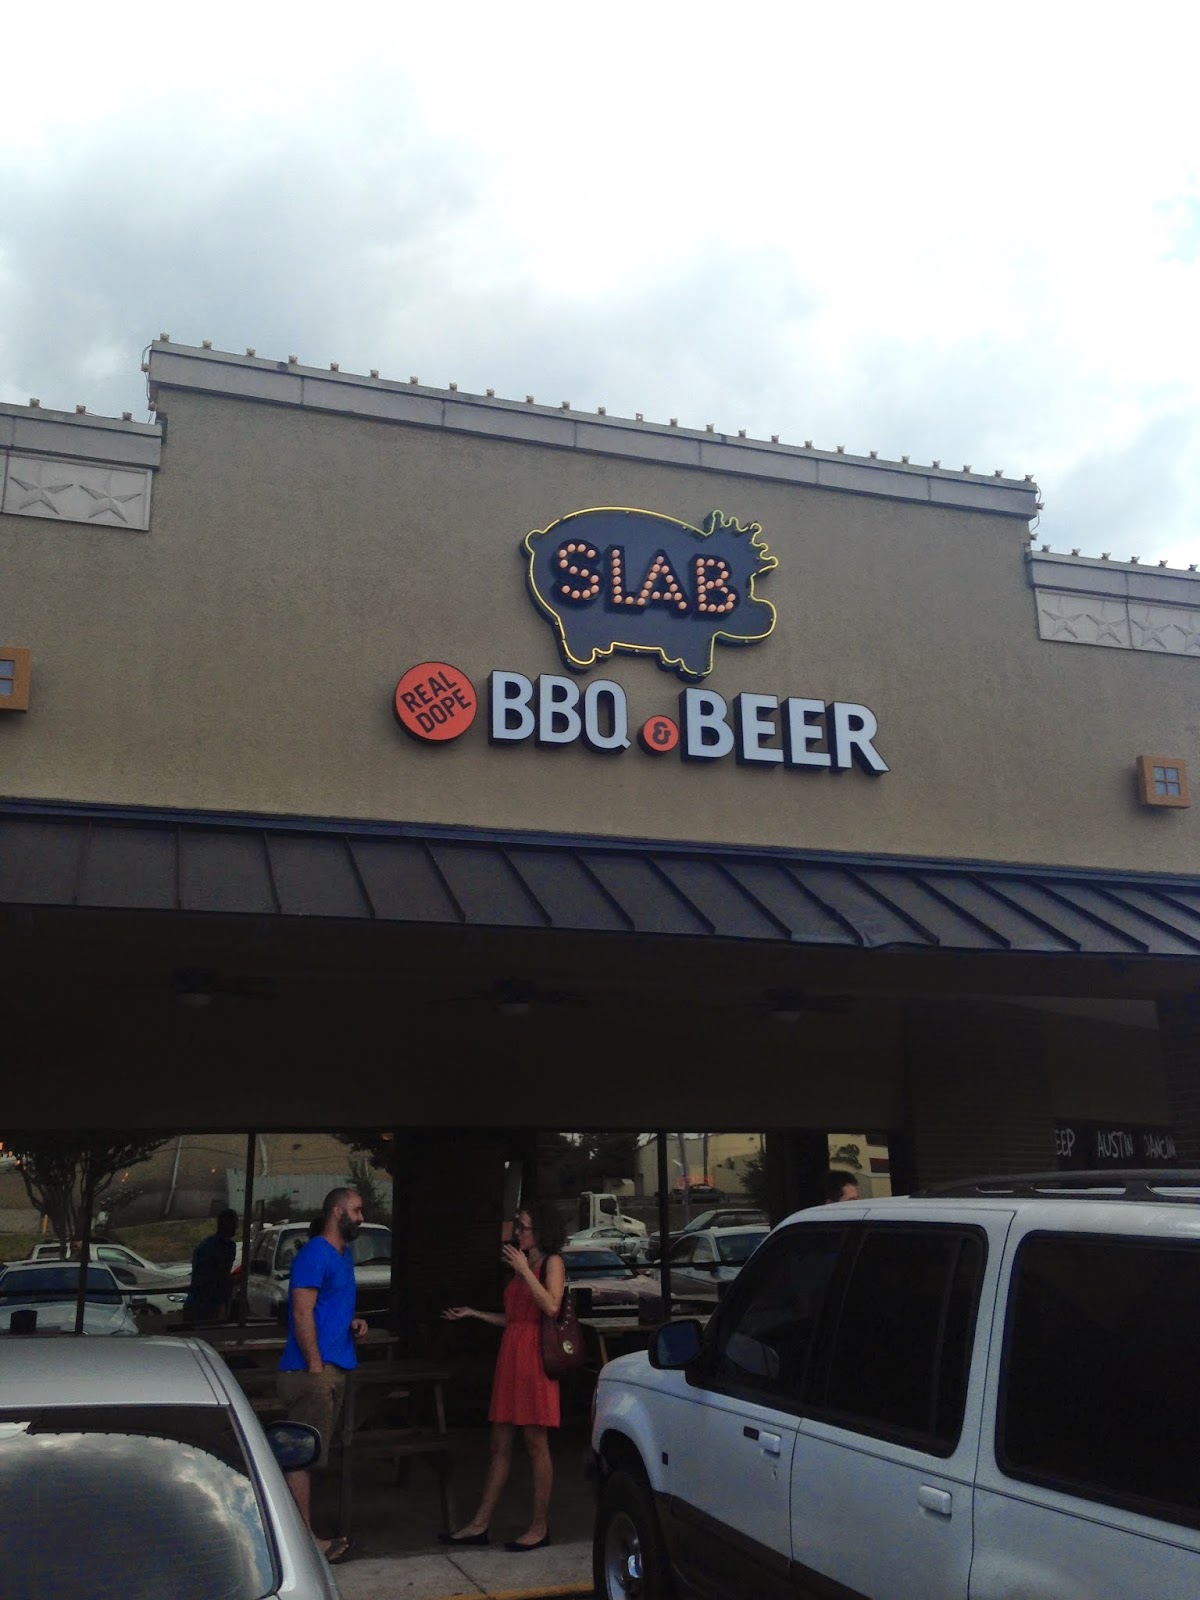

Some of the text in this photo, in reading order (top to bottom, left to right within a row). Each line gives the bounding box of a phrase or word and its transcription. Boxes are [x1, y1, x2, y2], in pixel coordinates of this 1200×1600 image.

[556, 541, 738, 615] SLAB
[400, 670, 458, 713] REAL
[415, 688, 472, 734] DOPE
[489, 669, 890, 775] BBQ & BEER
[1096, 1129, 1135, 1159] AUSTIN
